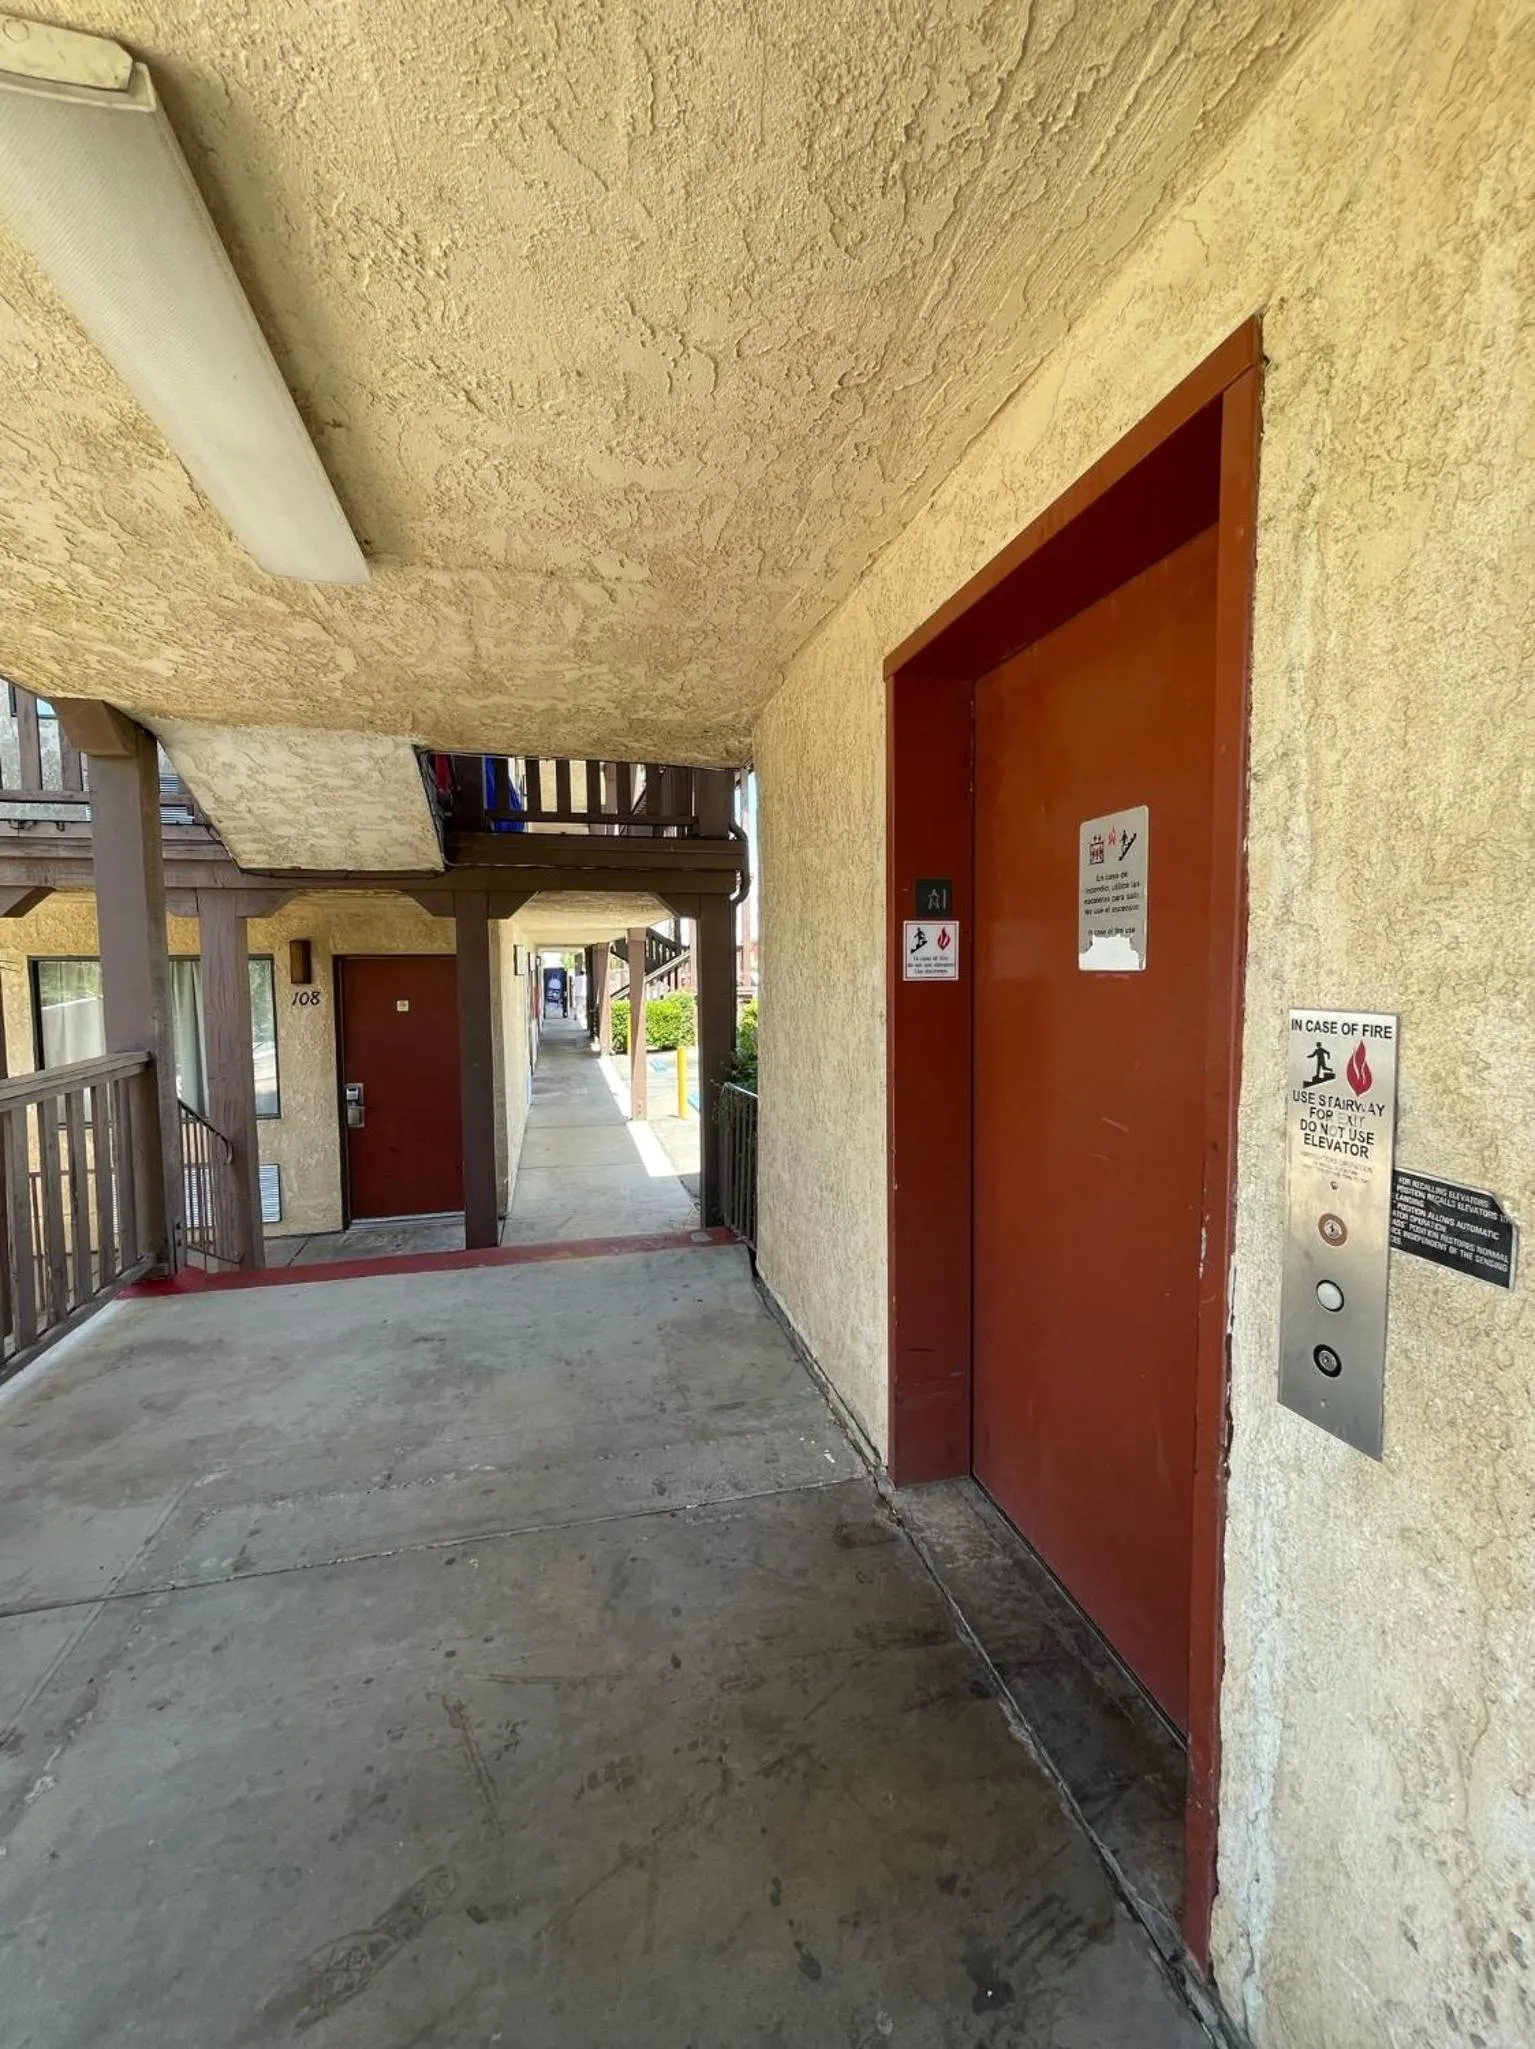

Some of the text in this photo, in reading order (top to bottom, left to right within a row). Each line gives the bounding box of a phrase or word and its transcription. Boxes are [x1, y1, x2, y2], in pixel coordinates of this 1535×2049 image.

[292, 991, 320, 1006] 108
[1291, 1019, 1393, 1038] IN CASE OF FIRE
[1292, 1090, 1315, 1104] USE
[1309, 1107, 1365, 1128] FOR EXIT
[1300, 1119, 1374, 1145] DO NOT USE
[1304, 1134, 1369, 1159] ELEVATOR
[1448, 1190, 1488, 1208] ELEVATORS
[1457, 1201, 1497, 1220] ELEVATORS
[1427, 1211, 1454, 1226] ALLOWS
[1456, 1220, 1499, 1240] AUTOMATIC
[1460, 1249, 1472, 1261] THE
[1476, 1245, 1508, 1263] NORMAL
